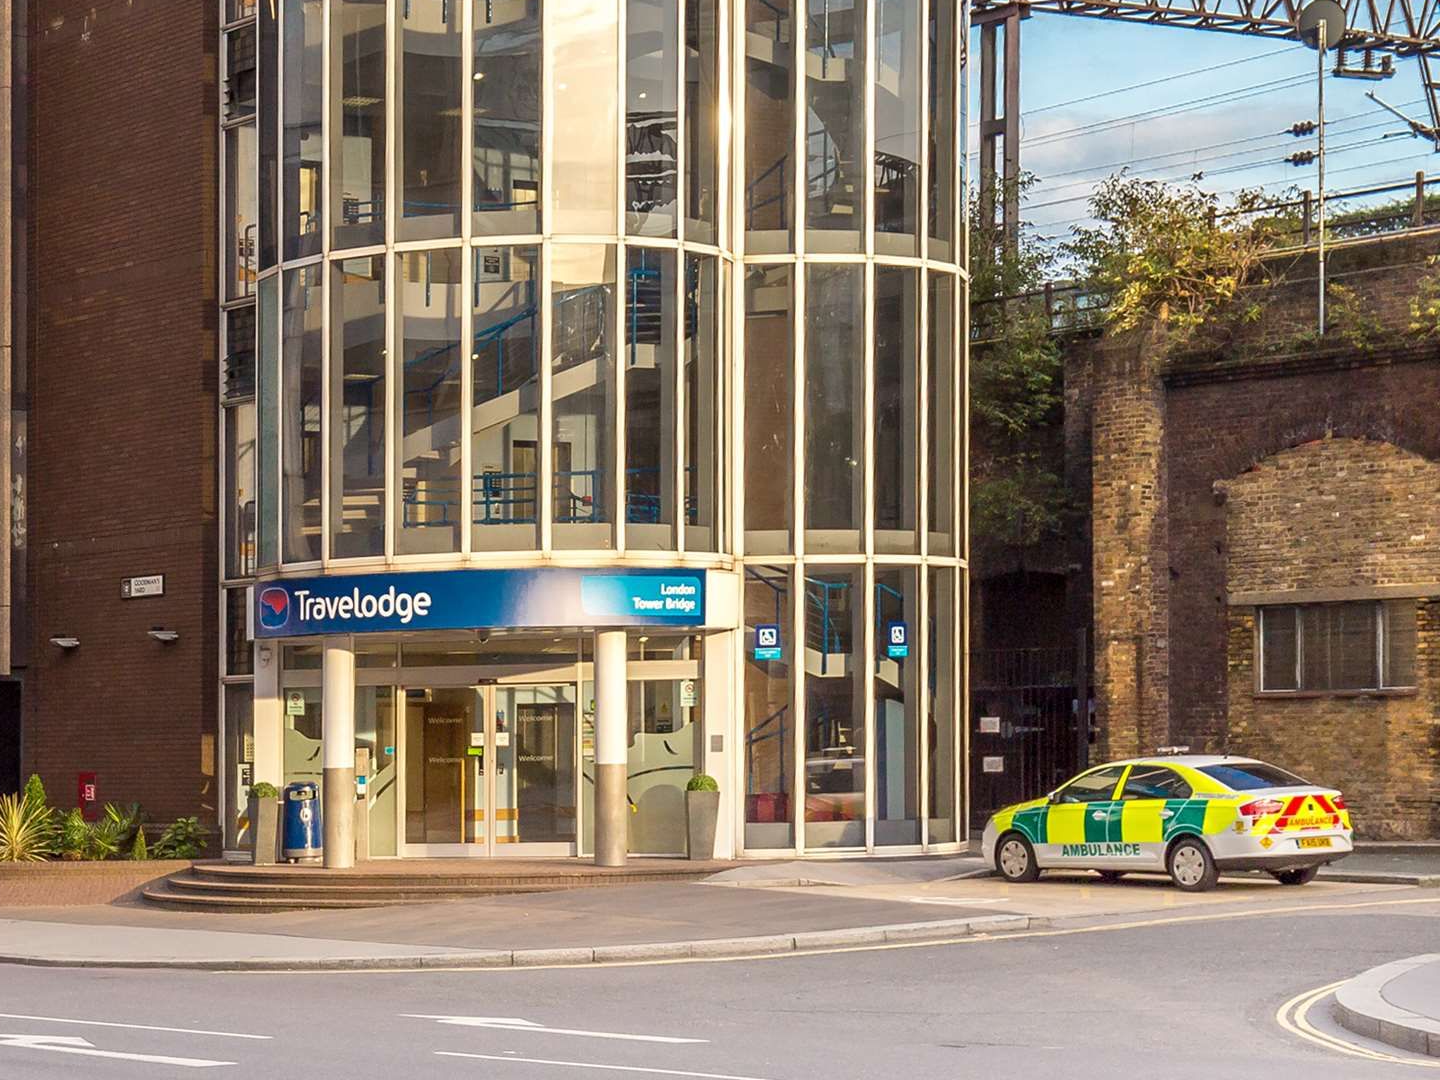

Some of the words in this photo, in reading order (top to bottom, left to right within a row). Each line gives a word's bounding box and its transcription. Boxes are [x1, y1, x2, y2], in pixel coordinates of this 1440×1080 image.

[661, 583, 696, 595] London
[294, 585, 432, 624] Travelodge
[632, 596, 664, 609] Tower
[665, 597, 696, 613] Bridge
[1289, 817, 1333, 825] AMBULANCE
[1062, 843, 1141, 857] AMBULANCE
